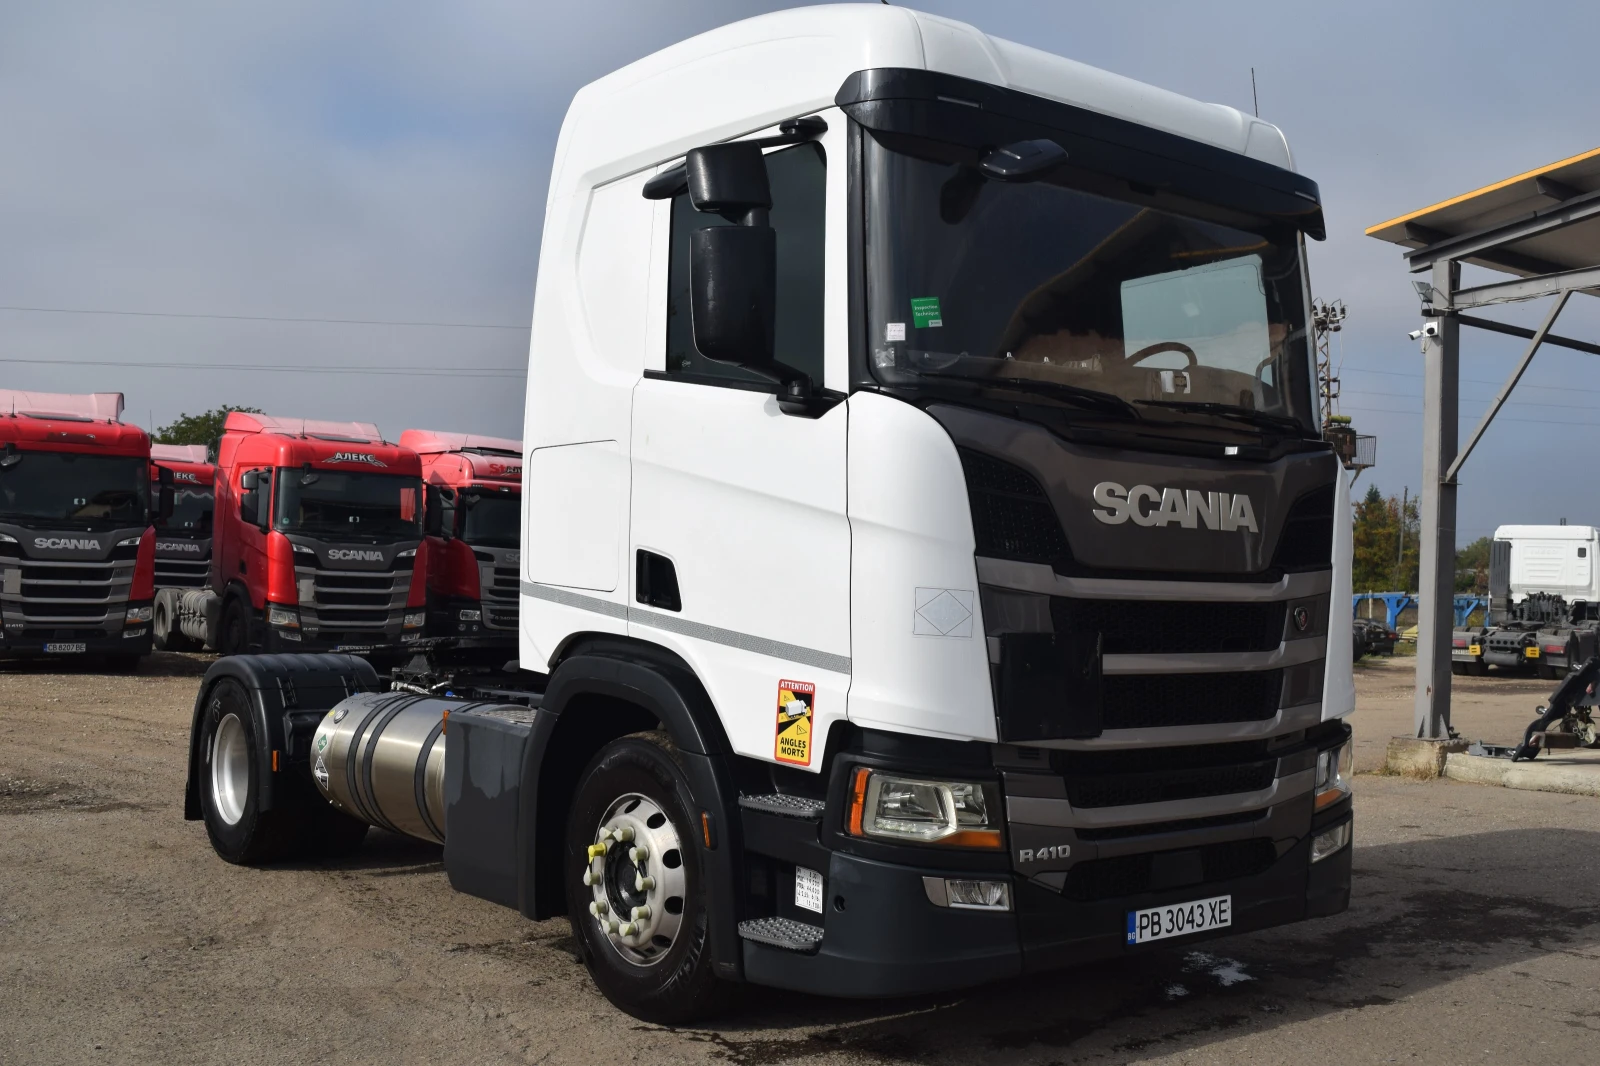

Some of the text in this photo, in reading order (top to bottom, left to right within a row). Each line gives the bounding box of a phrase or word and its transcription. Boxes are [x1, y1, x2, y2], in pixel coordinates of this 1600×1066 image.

[334, 452, 375, 462] АЛЕКС
[1092, 481, 1259, 533] SCANIA
[34, 537, 101, 550] SCANIA
[155, 542, 200, 553] SCANIA
[328, 549, 384, 562] SCANIA
[780, 680, 814, 693] ATTENTION
[780, 736, 807, 749] ANGLES
[781, 746, 805, 758] MORTS
[1019, 844, 1071, 863] R 410
[1140, 899, 1228, 939] PB 3043 XE
[1127, 932, 1136, 941] BG
